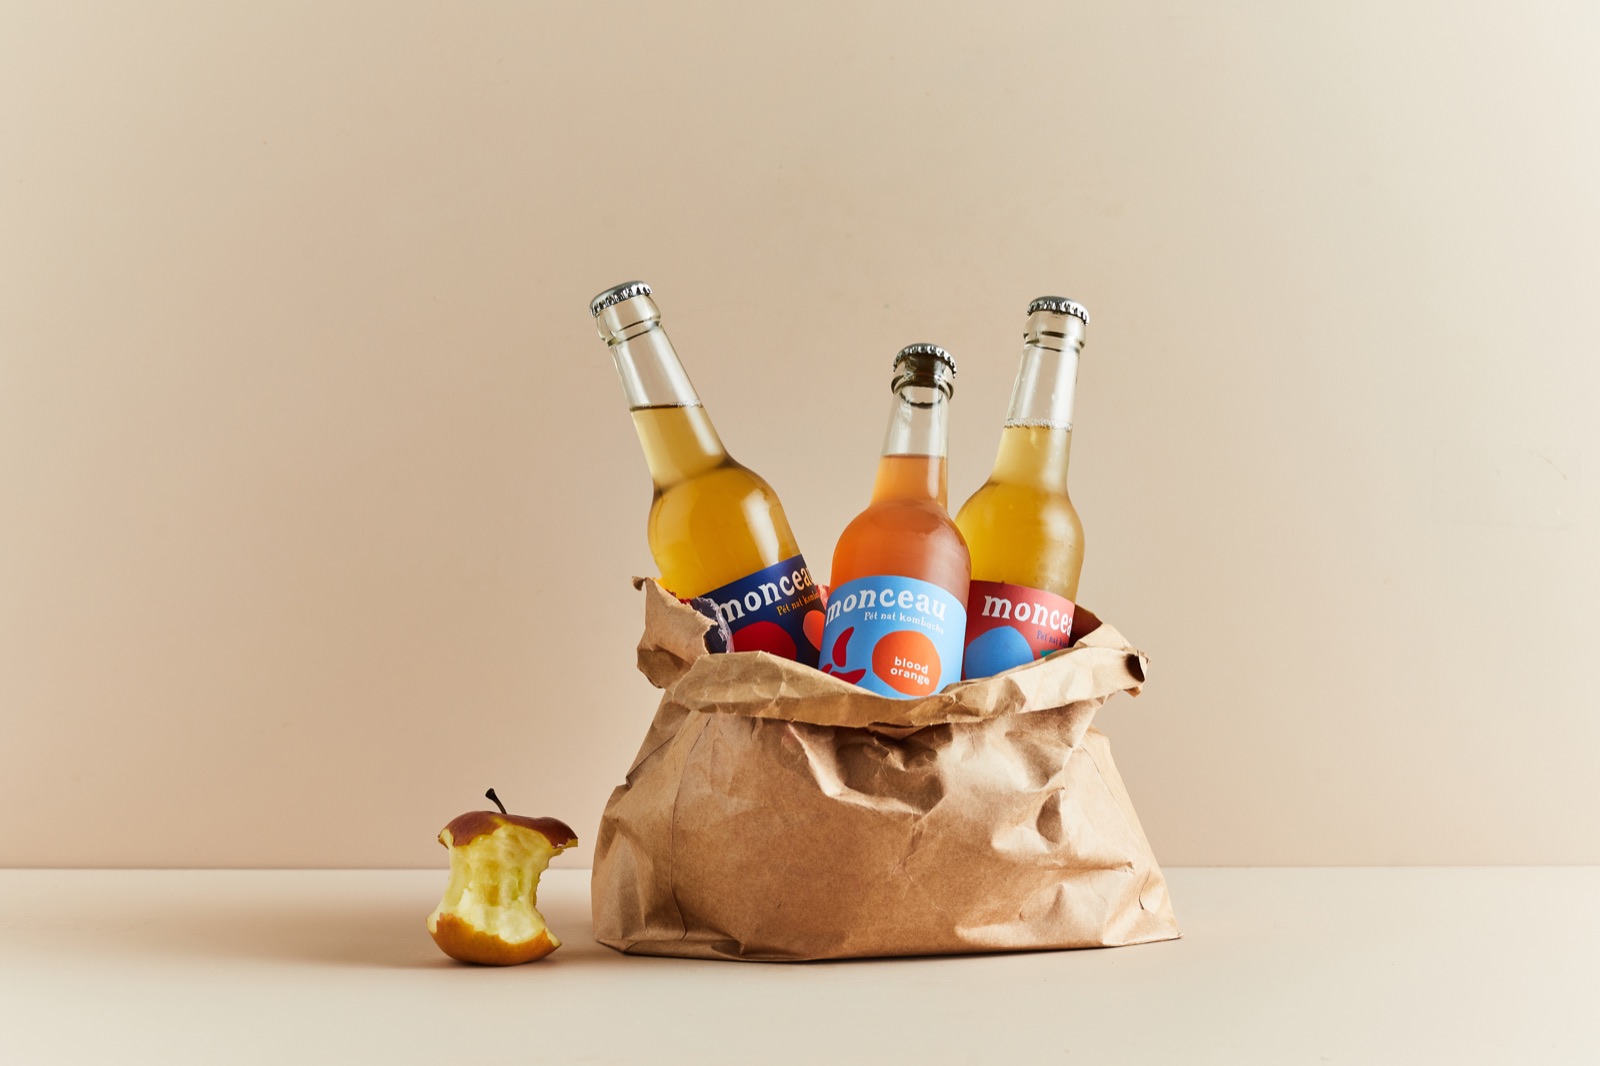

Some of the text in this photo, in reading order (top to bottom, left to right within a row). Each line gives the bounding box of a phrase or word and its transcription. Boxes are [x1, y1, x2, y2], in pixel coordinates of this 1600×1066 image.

[718, 567, 813, 623] moncea
[791, 598, 804, 610] nat
[825, 588, 947, 627] monceau
[881, 611, 896, 621] nat
[899, 611, 944, 635] kombucha
[1048, 636, 1059, 647] nat
[894, 656, 929, 675] blood
[890, 667, 931, 685] orange
